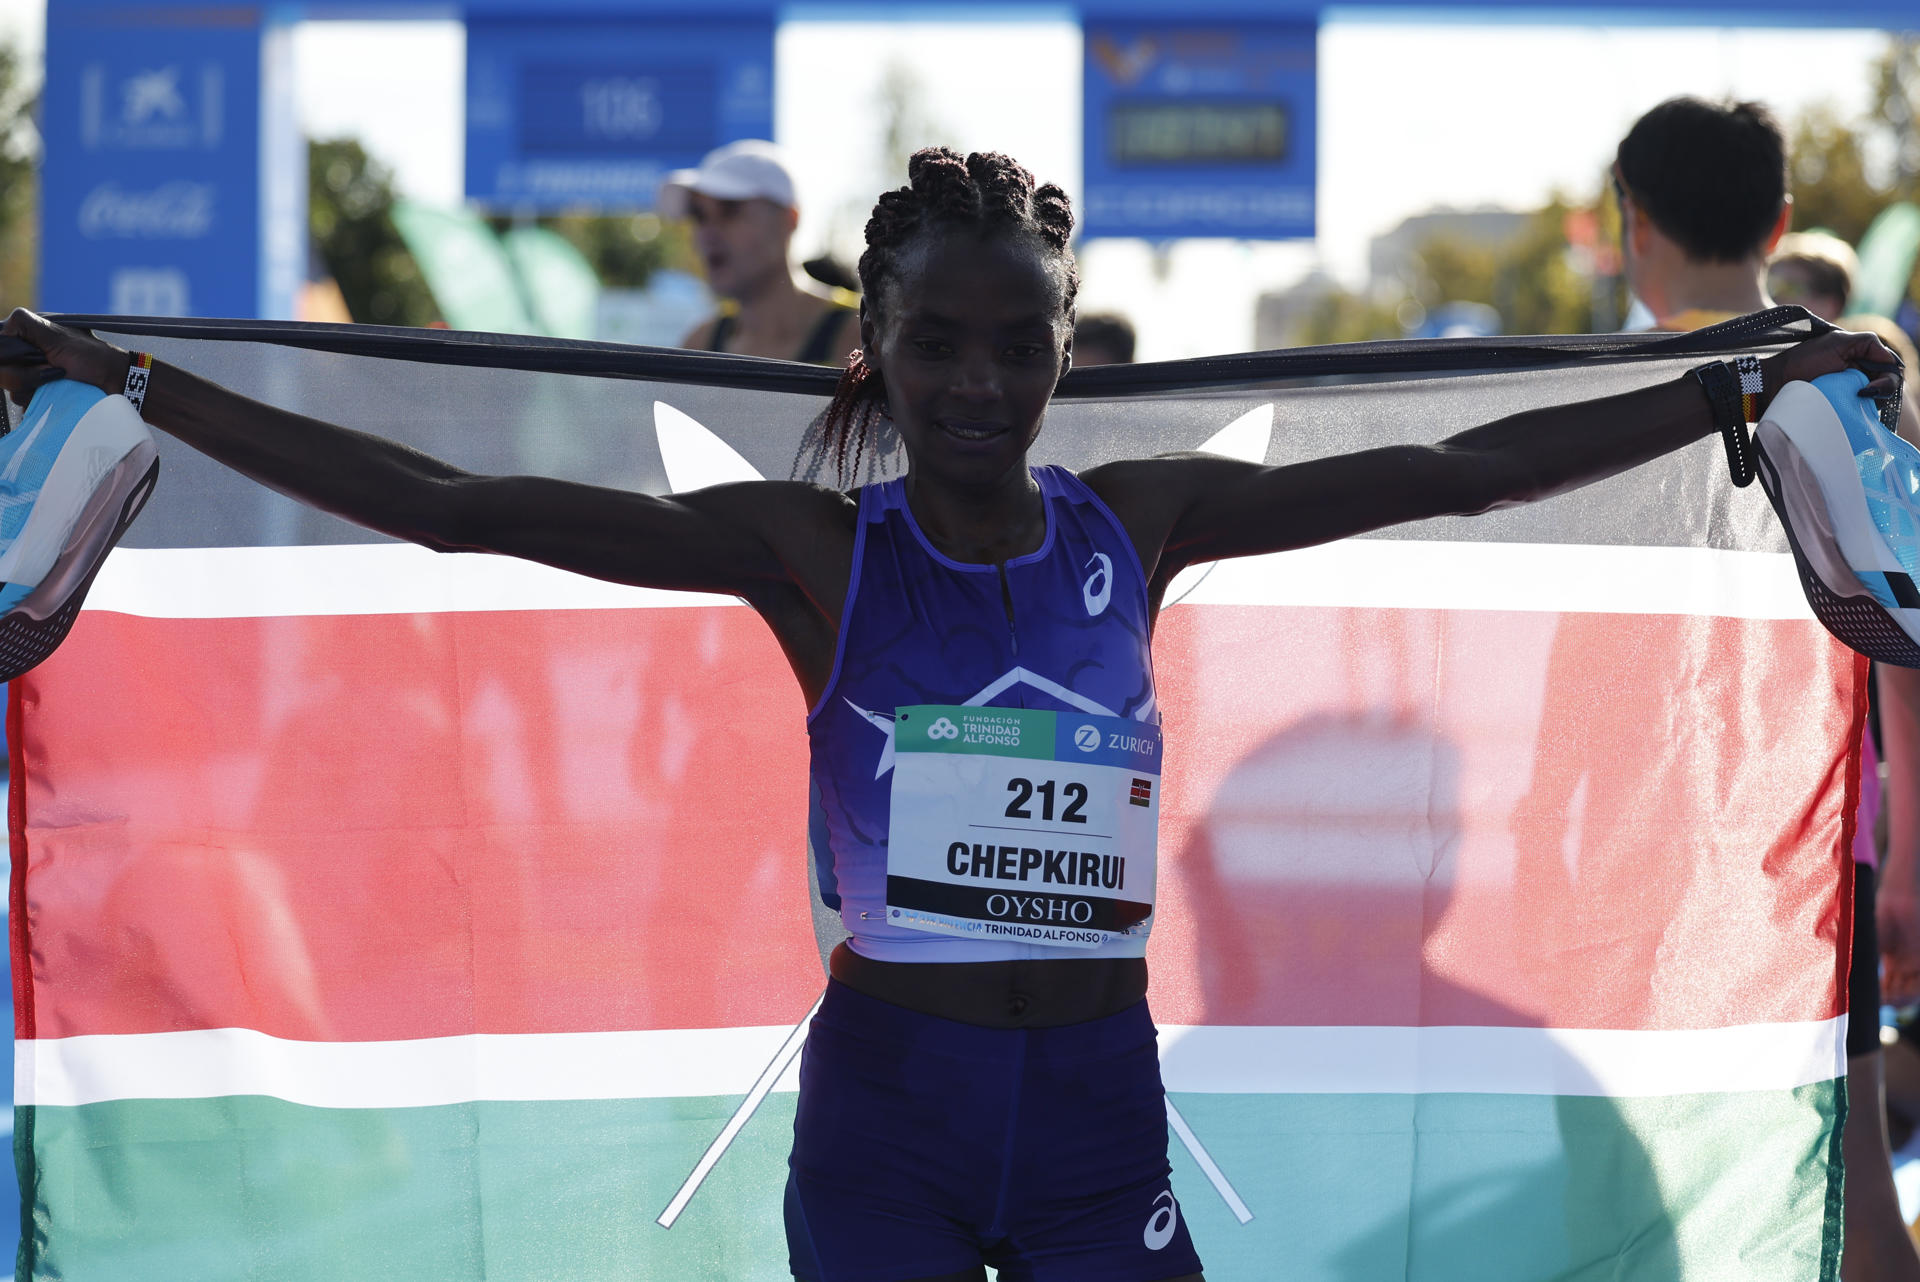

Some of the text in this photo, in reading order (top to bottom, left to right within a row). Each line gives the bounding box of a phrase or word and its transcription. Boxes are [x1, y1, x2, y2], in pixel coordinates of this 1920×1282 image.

[962, 723, 1021, 736] TRINIDAD
[962, 734, 1021, 746] ALFONSO
[1108, 734, 1154, 755] ZURICH
[1004, 777, 1089, 824] 212
[946, 841, 1126, 890] CHEPKIRUI
[986, 894, 1093, 923] OYSHO
[985, 923, 1046, 940] TRINIDAD
[1043, 929, 1100, 944] ALFONSO
